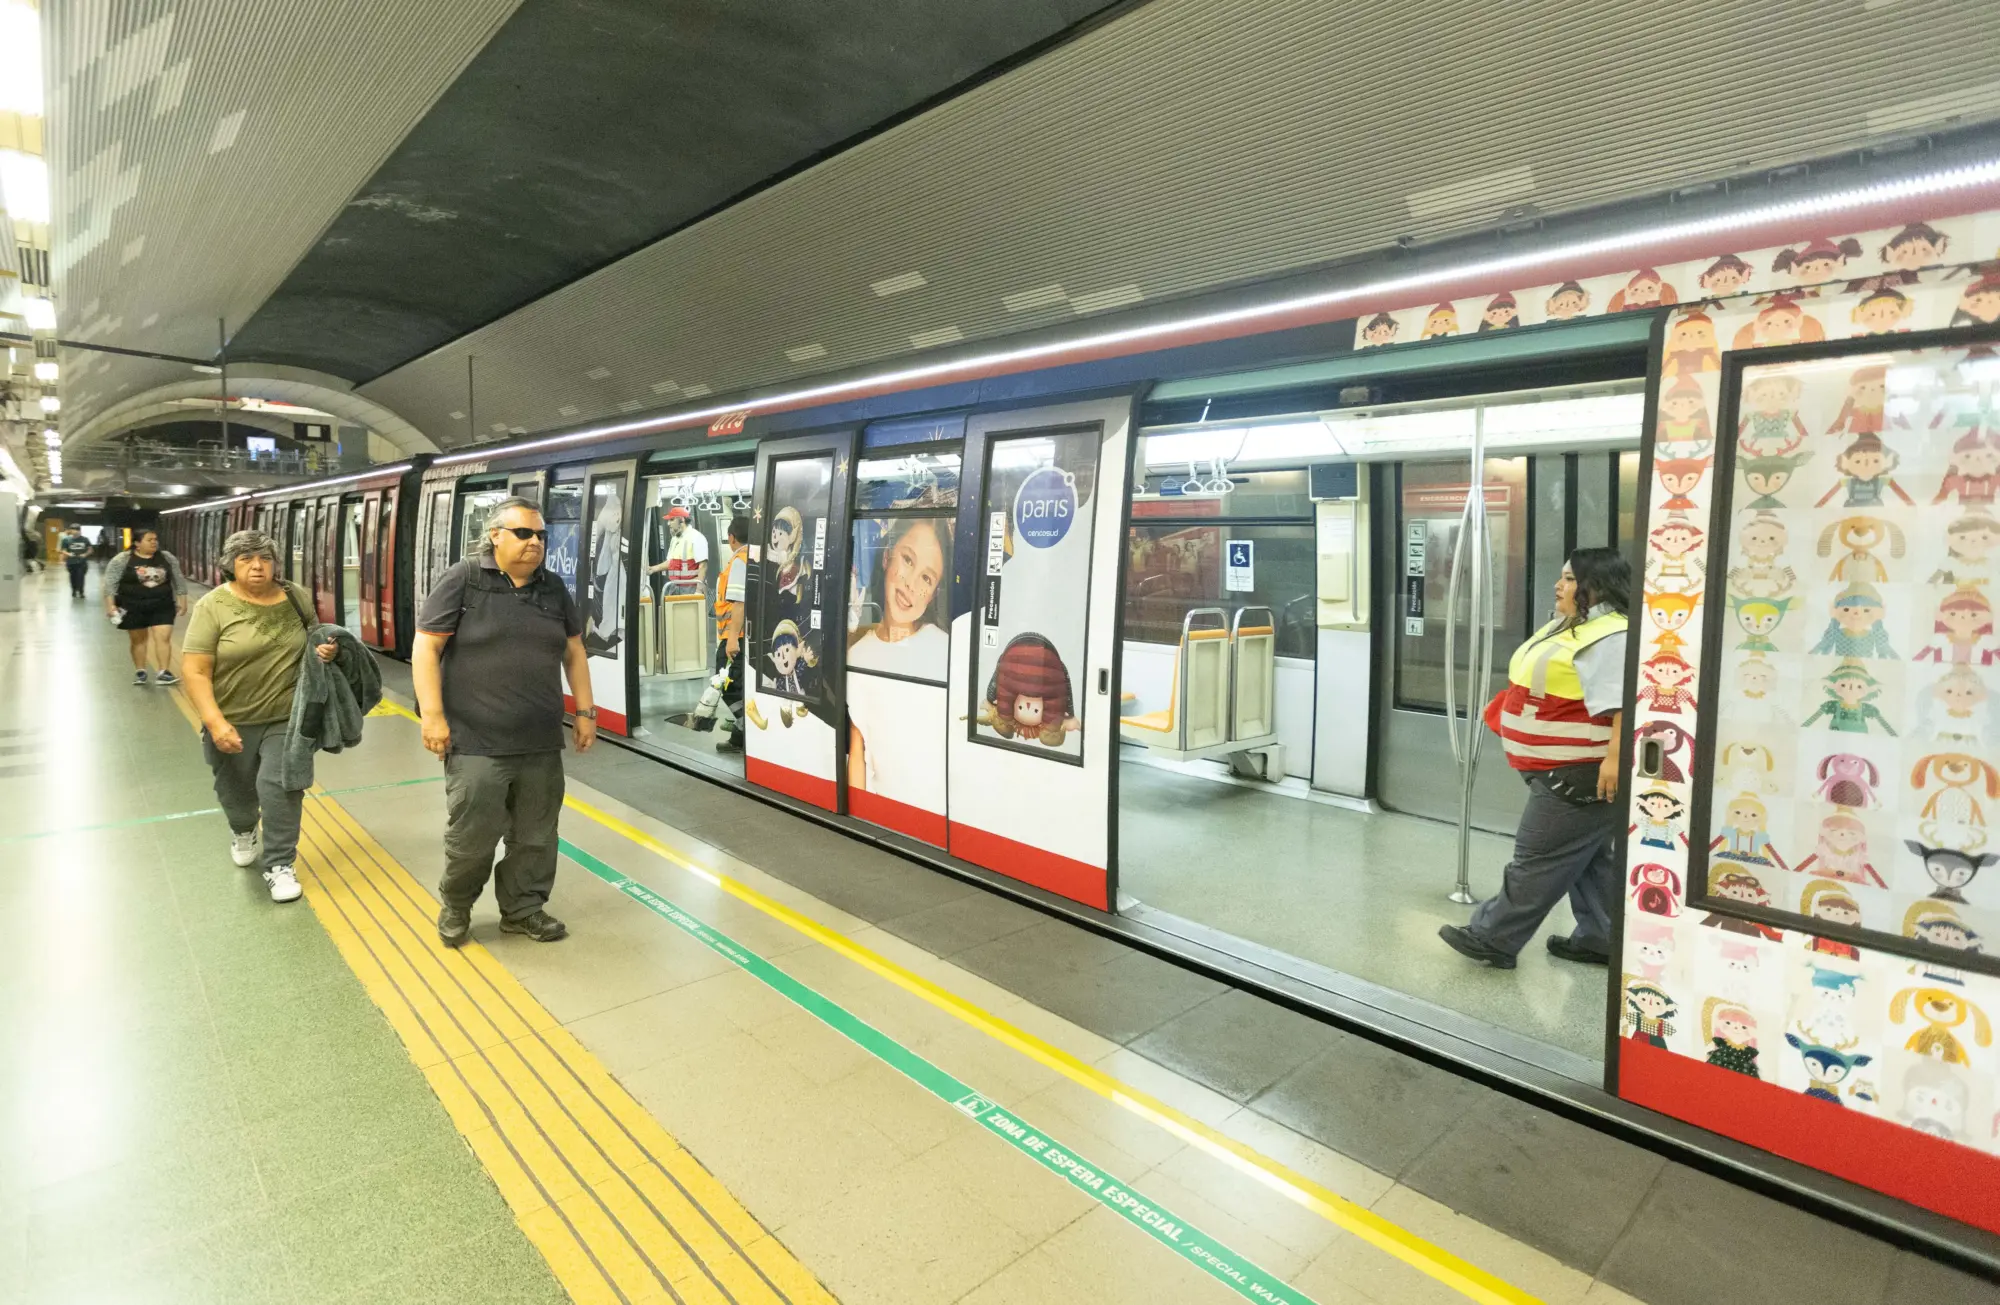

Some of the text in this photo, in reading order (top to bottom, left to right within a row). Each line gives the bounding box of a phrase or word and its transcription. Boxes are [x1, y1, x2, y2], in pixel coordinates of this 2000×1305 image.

[1021, 499, 1068, 523] paris
[1027, 528, 1059, 537] cencosud
[987, 1113, 1026, 1140] ZONA
[1022, 1135, 1048, 1153] DE
[1043, 1148, 1105, 1190] ESPERA
[1102, 1185, 1184, 1242] ESPECIAL
